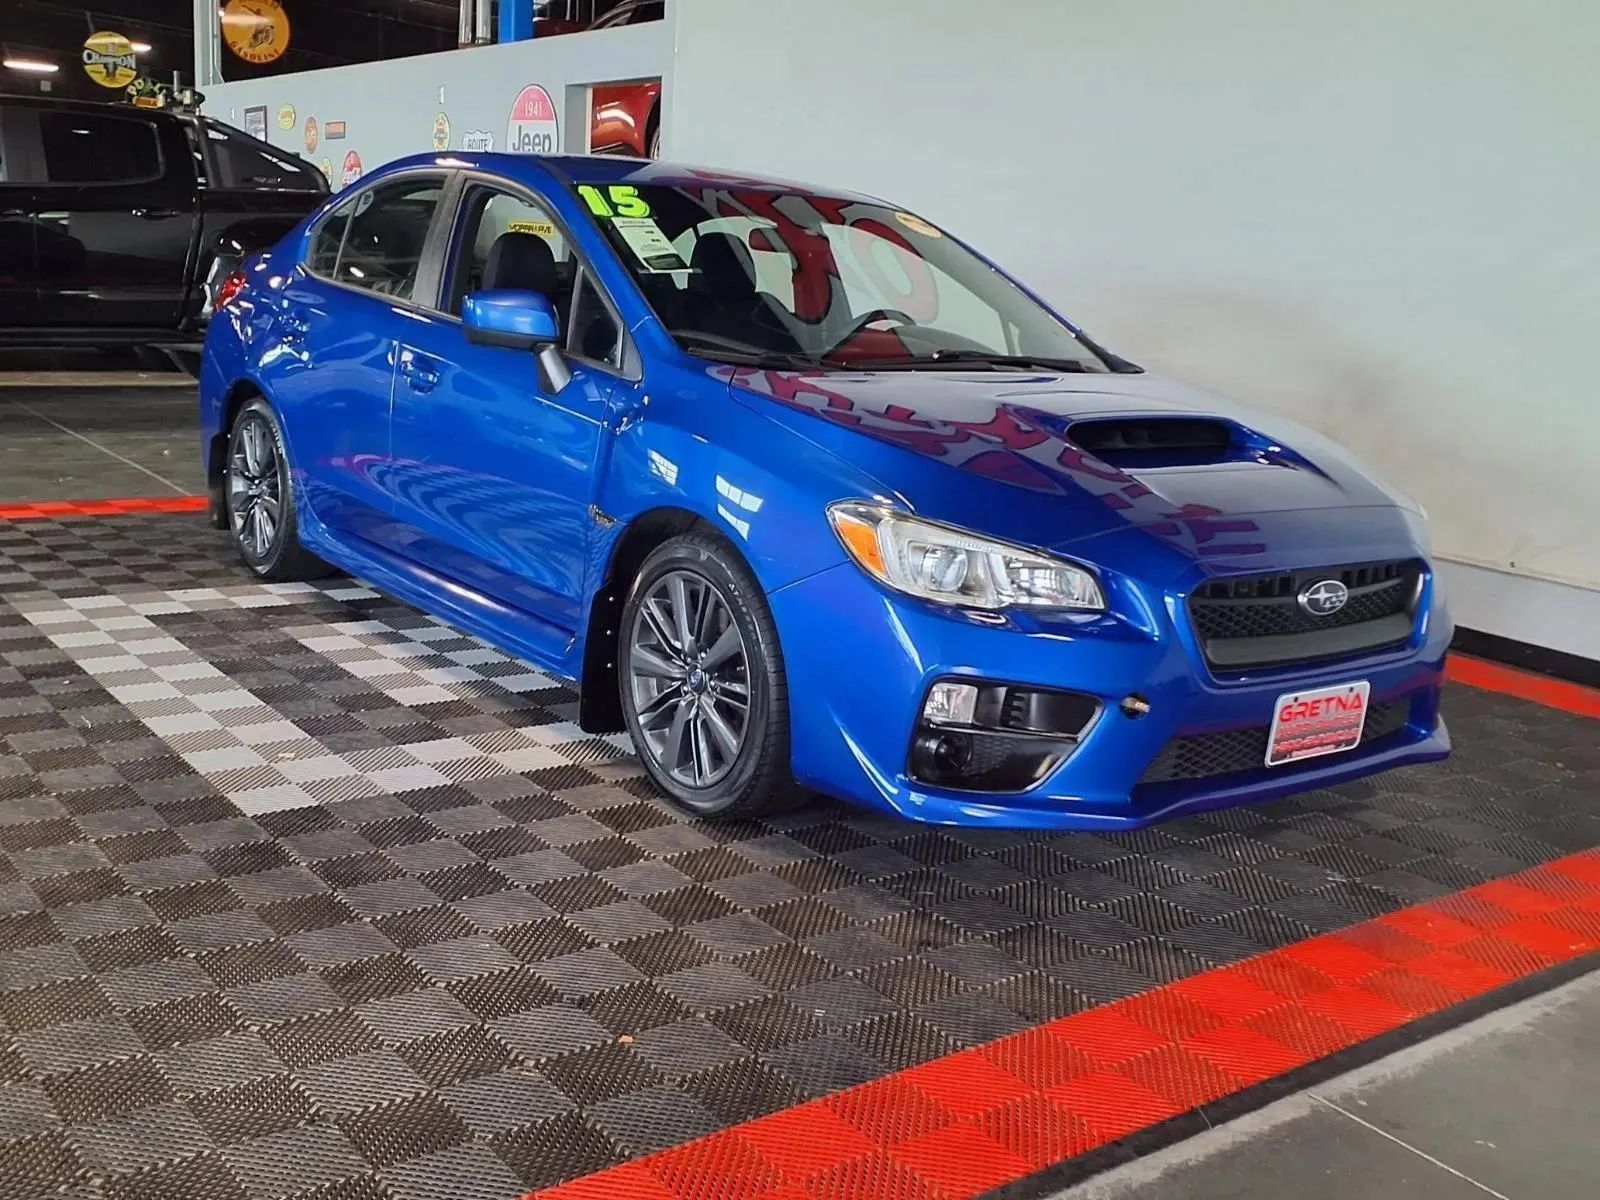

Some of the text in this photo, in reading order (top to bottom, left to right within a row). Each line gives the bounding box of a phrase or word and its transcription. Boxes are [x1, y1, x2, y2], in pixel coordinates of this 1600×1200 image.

[525, 100, 542, 116] 1941
[512, 125, 552, 152] Jeep
[577, 185, 650, 218] 15
[1280, 693, 1363, 722] GRETNA
